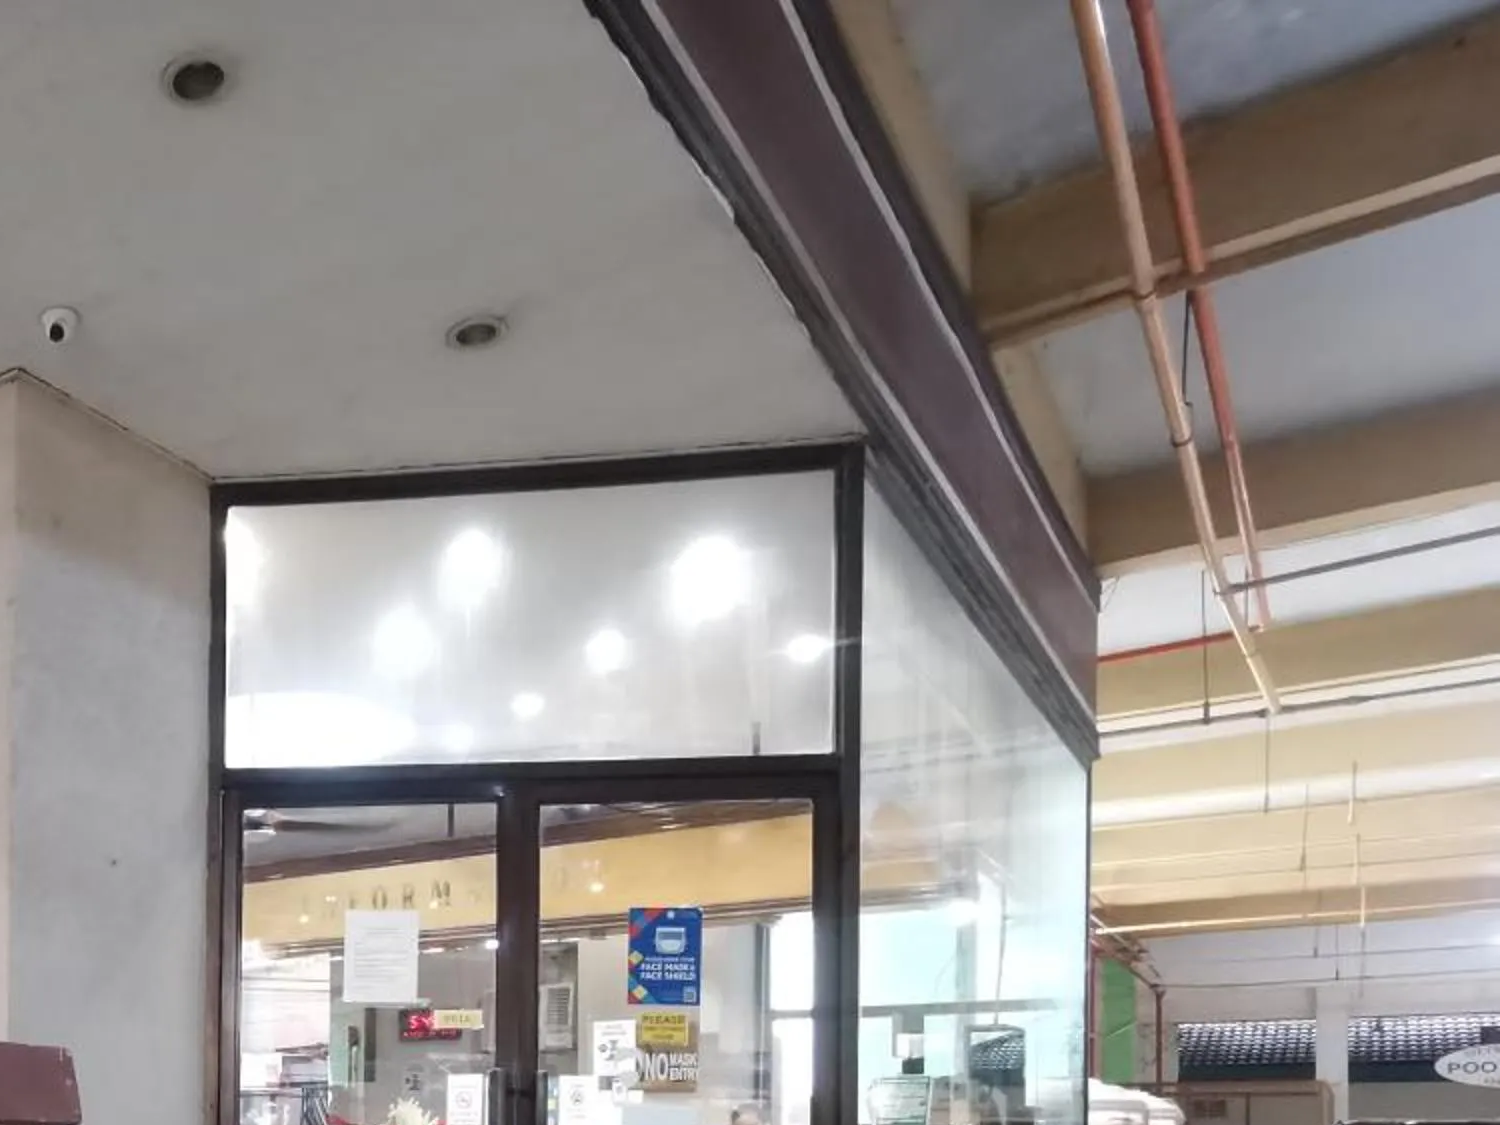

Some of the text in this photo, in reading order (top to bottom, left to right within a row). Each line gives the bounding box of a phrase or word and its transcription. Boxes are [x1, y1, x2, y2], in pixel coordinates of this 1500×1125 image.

[640, 963, 662, 971] FACE
[640, 972, 696, 980] FACE SHIELD
[645, 1052, 669, 1081] NO
